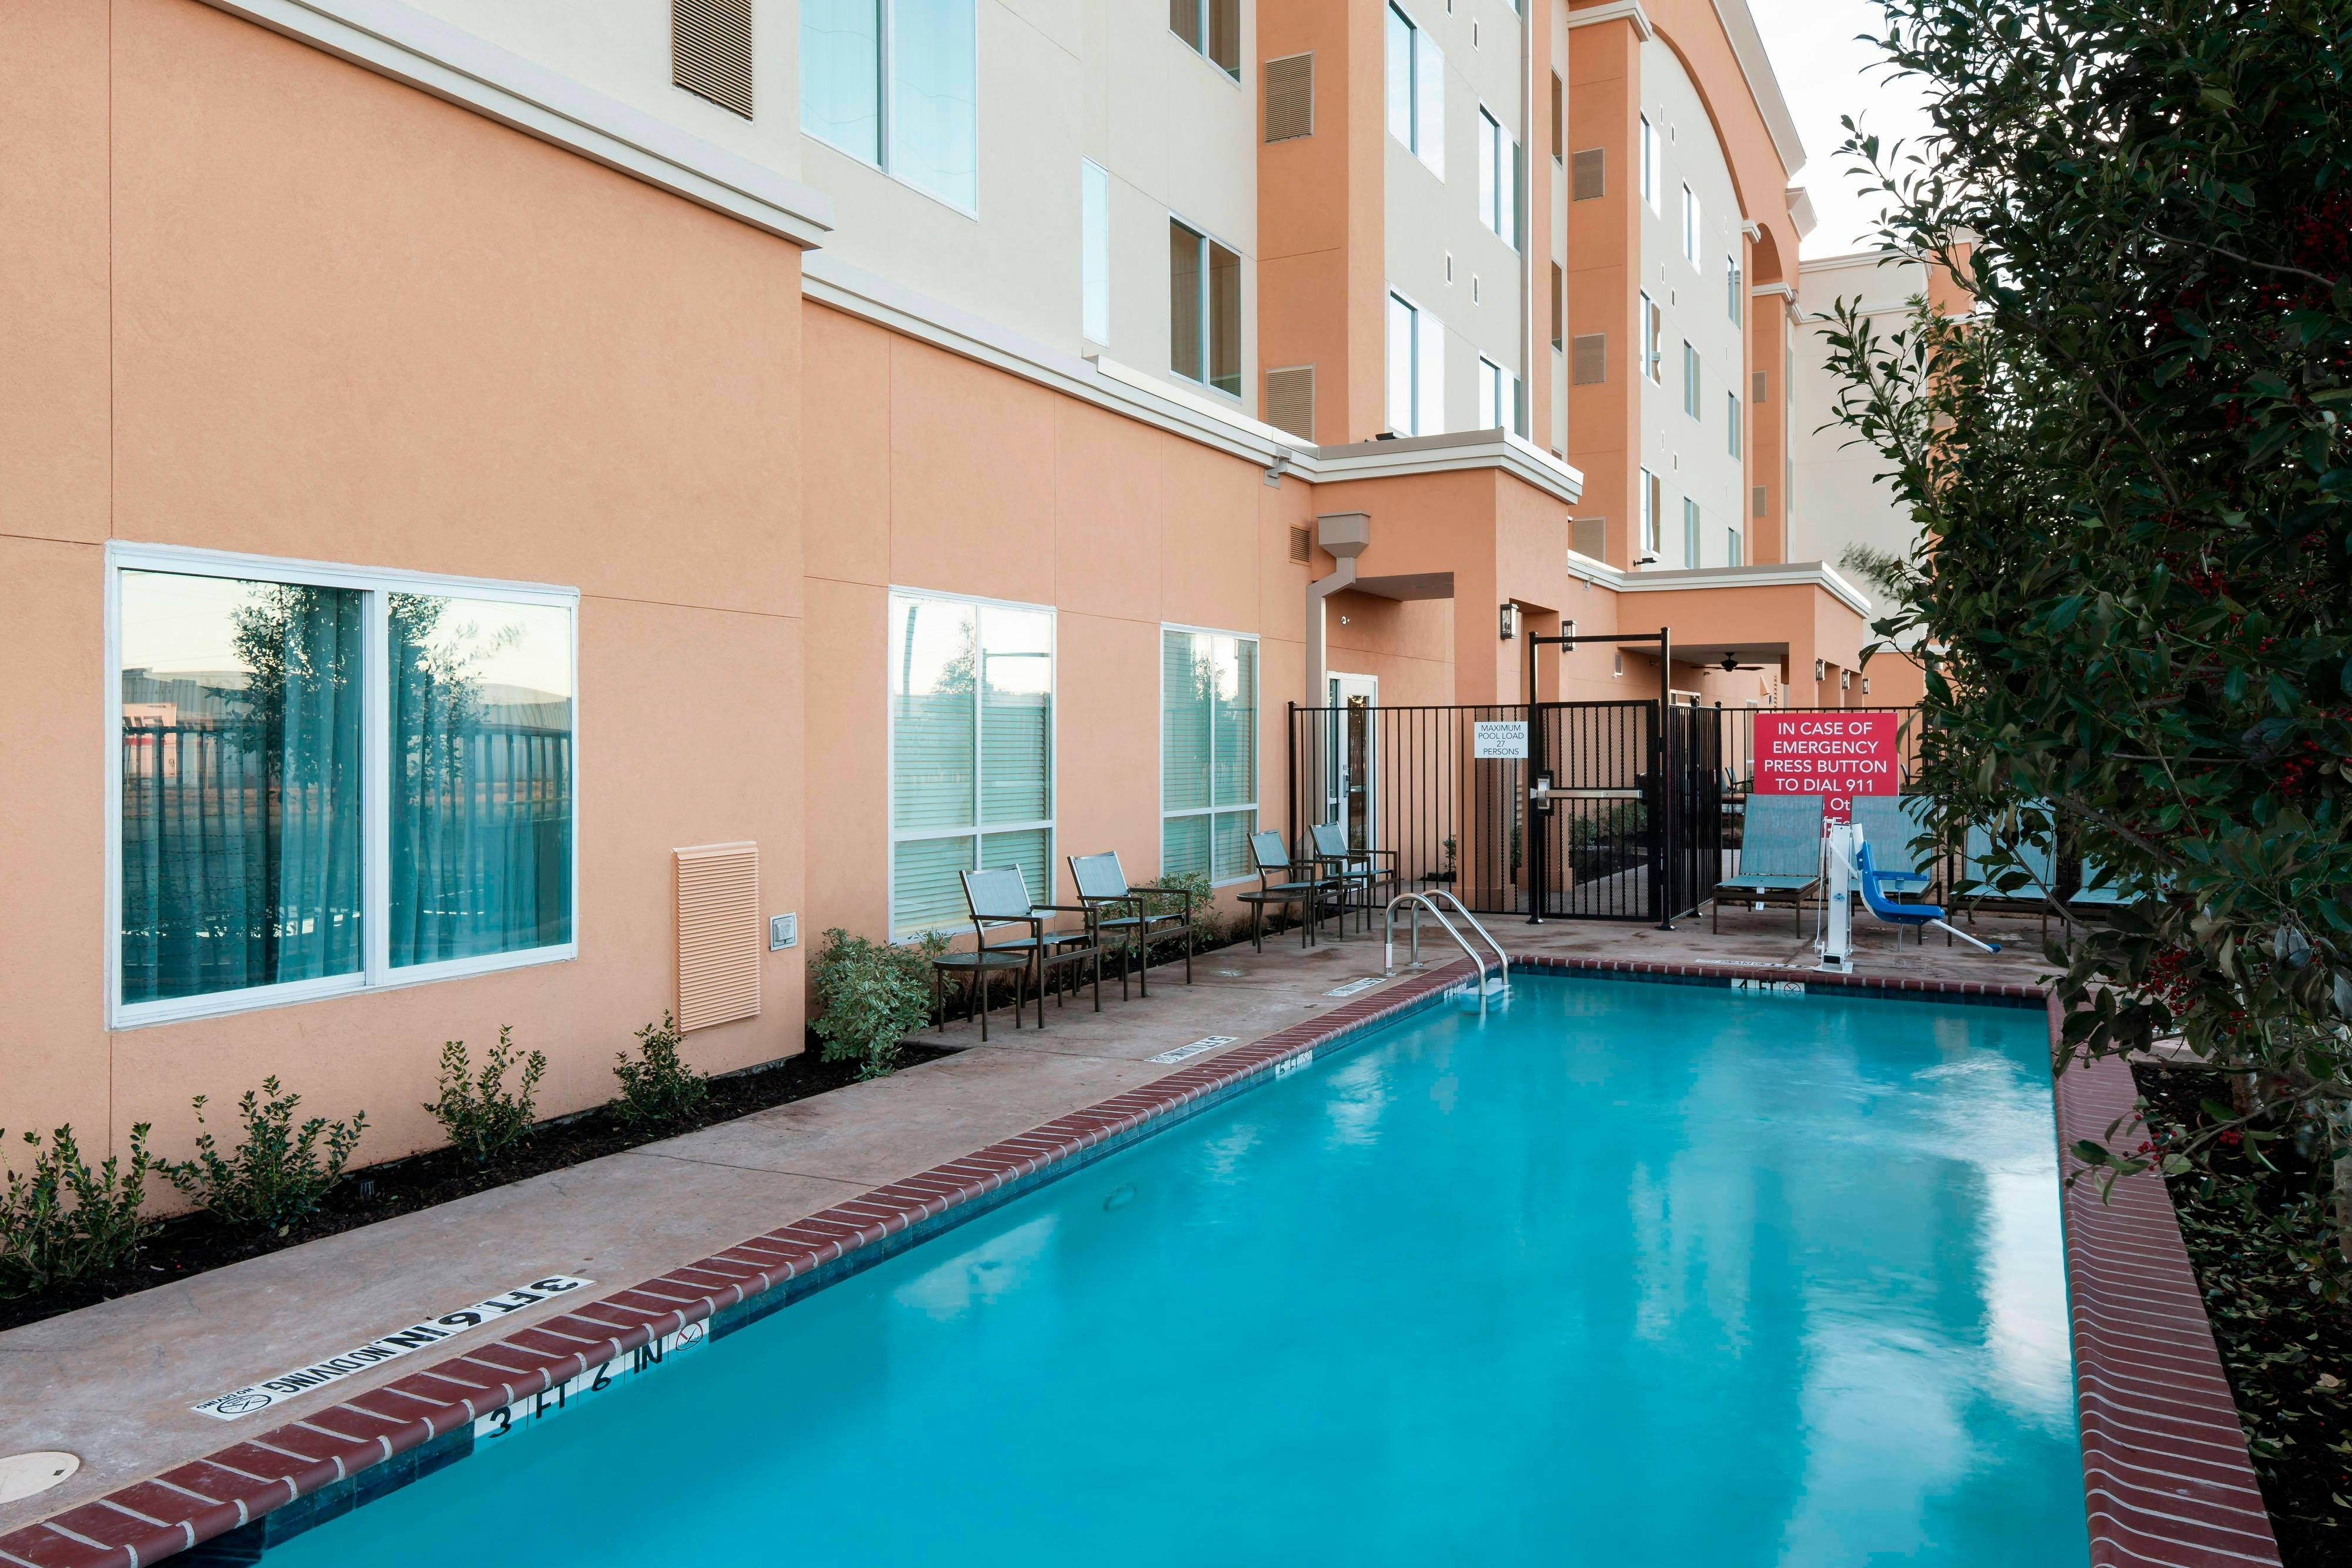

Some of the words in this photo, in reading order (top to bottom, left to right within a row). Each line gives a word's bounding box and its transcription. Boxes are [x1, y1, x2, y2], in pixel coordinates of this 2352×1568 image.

[1778, 723, 1795, 735] IN
[1800, 722, 1843, 735] CASE
[1849, 722, 1873, 735] OF
[1773, 741, 1879, 754] EMERGENCY
[1765, 760, 1812, 773] PRESS
[1818, 760, 1887, 773] BUTTON
[1775, 778, 1799, 791] TO
[1804, 779, 1842, 791] DIAL
[1846, 779, 1873, 792] 911
[1759, 980, 1777, 991] FT
[530, 1278, 579, 1292] 3
[437, 1312, 482, 1327] 6
[350, 1346, 397, 1362] NO
[261, 1358, 366, 1393] DIVING
[489, 1406, 512, 1438] 3
[536, 1378, 572, 1419] FT
[591, 1362, 612, 1392] 6
[634, 1339, 663, 1375] IN
[196, 1393, 238, 1410] DIVING
